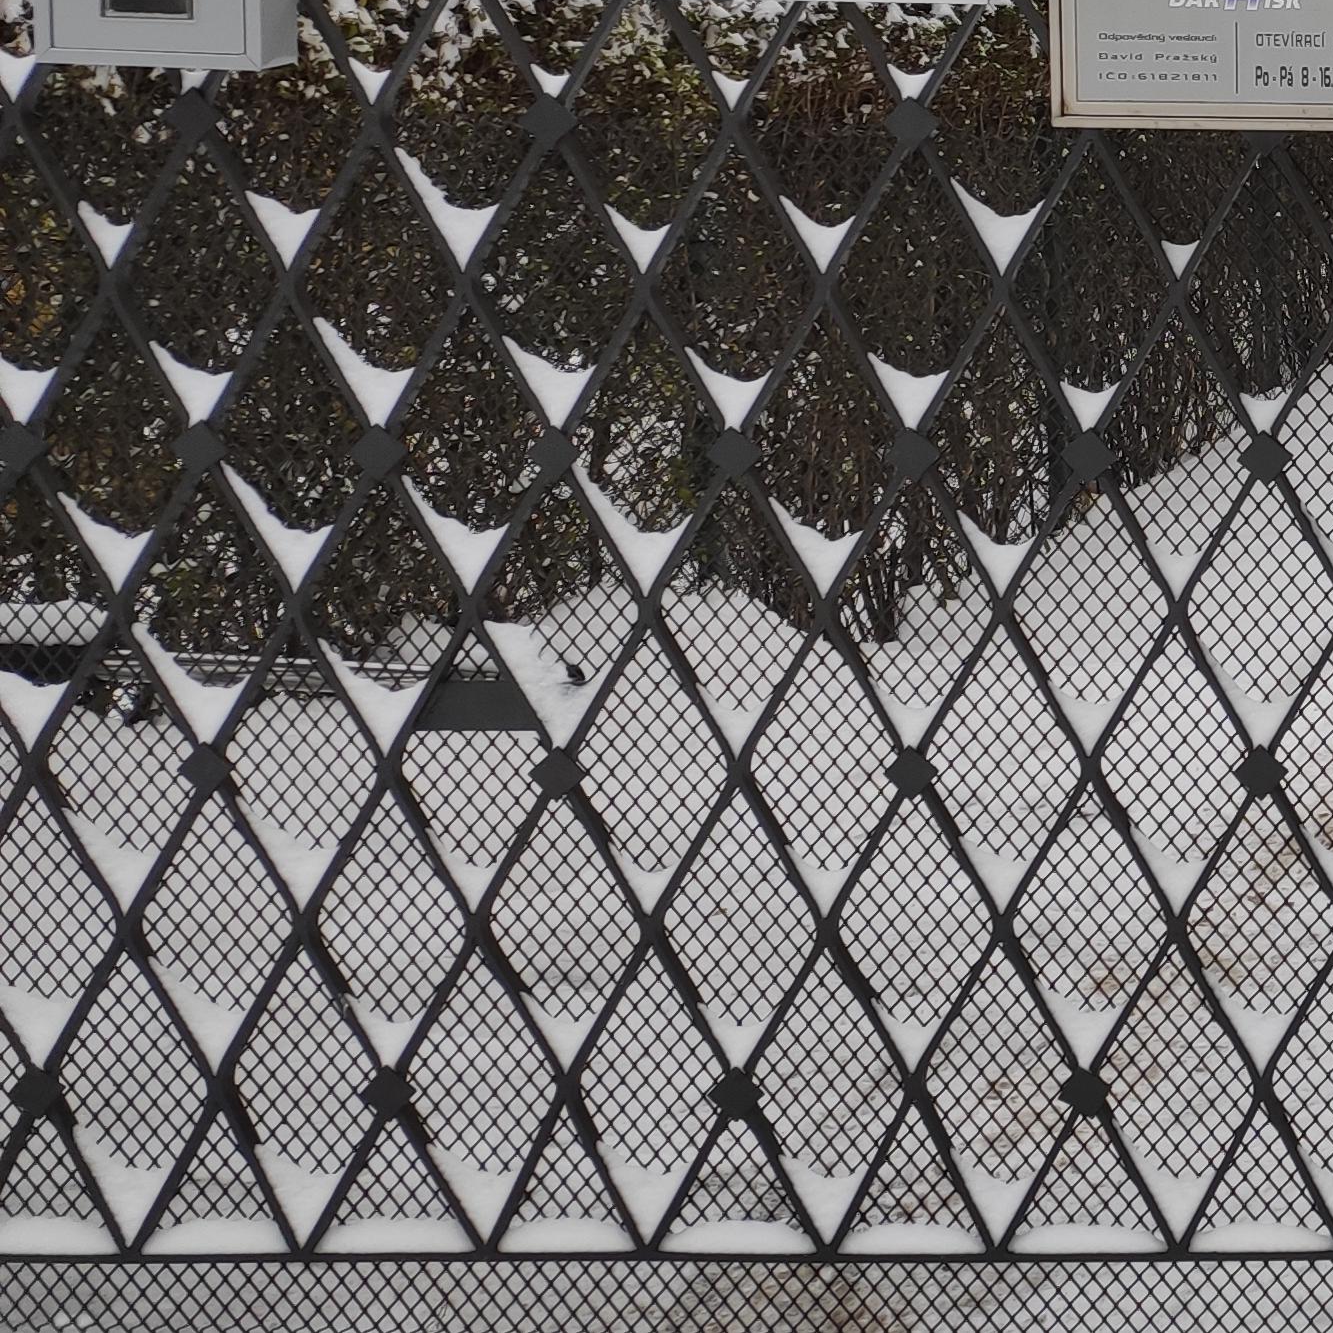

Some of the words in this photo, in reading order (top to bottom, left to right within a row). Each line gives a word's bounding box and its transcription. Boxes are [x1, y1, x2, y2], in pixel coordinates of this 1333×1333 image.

[1099, 33, 1165, 42] Odpovědný
[1256, 31, 1326, 47] OTEVÍRACÍ
[1099, 52, 1143, 60] David
[1155, 54, 1217, 63] Pražský
[1255, 66, 1269, 87] Po
[1280, 66, 1293, 87] Pá
[1301, 67, 1309, 87] 8
